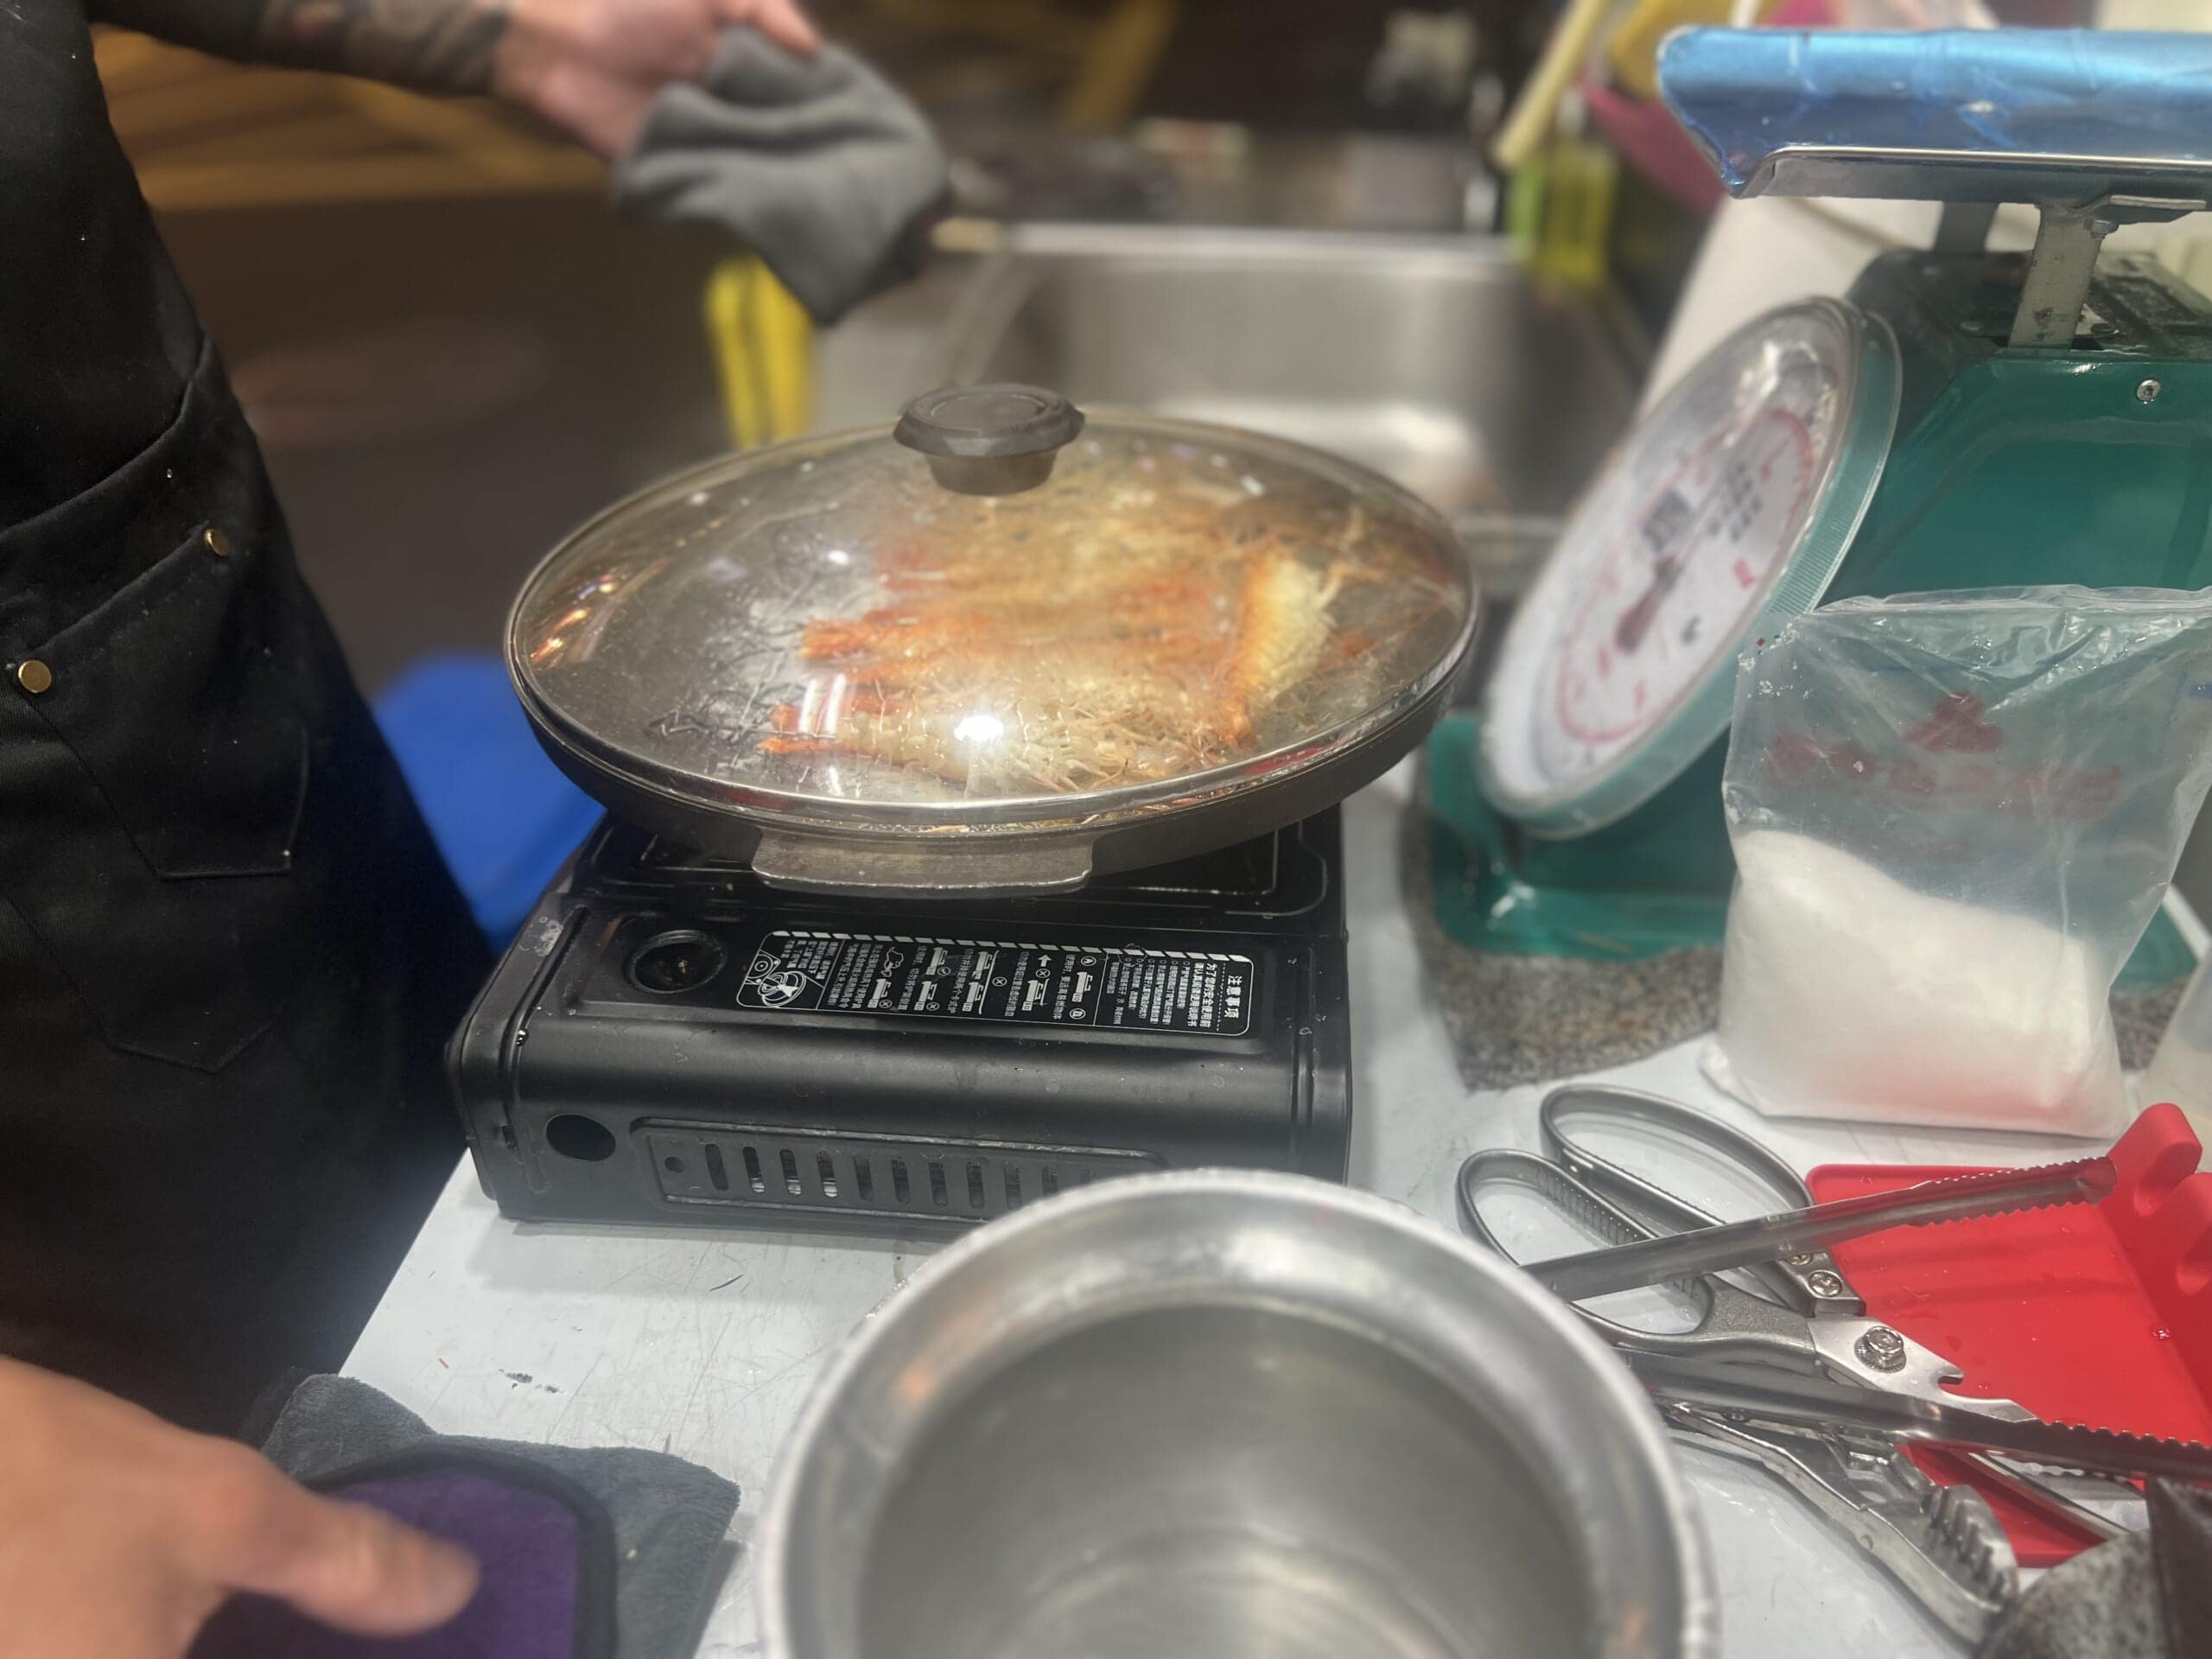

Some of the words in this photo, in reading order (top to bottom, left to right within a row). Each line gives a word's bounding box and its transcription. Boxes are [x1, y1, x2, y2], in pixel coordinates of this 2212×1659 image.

[1201, 963, 1217, 1027] 为了您的安全使用前
[1225, 975, 1243, 1019] 注意事项
